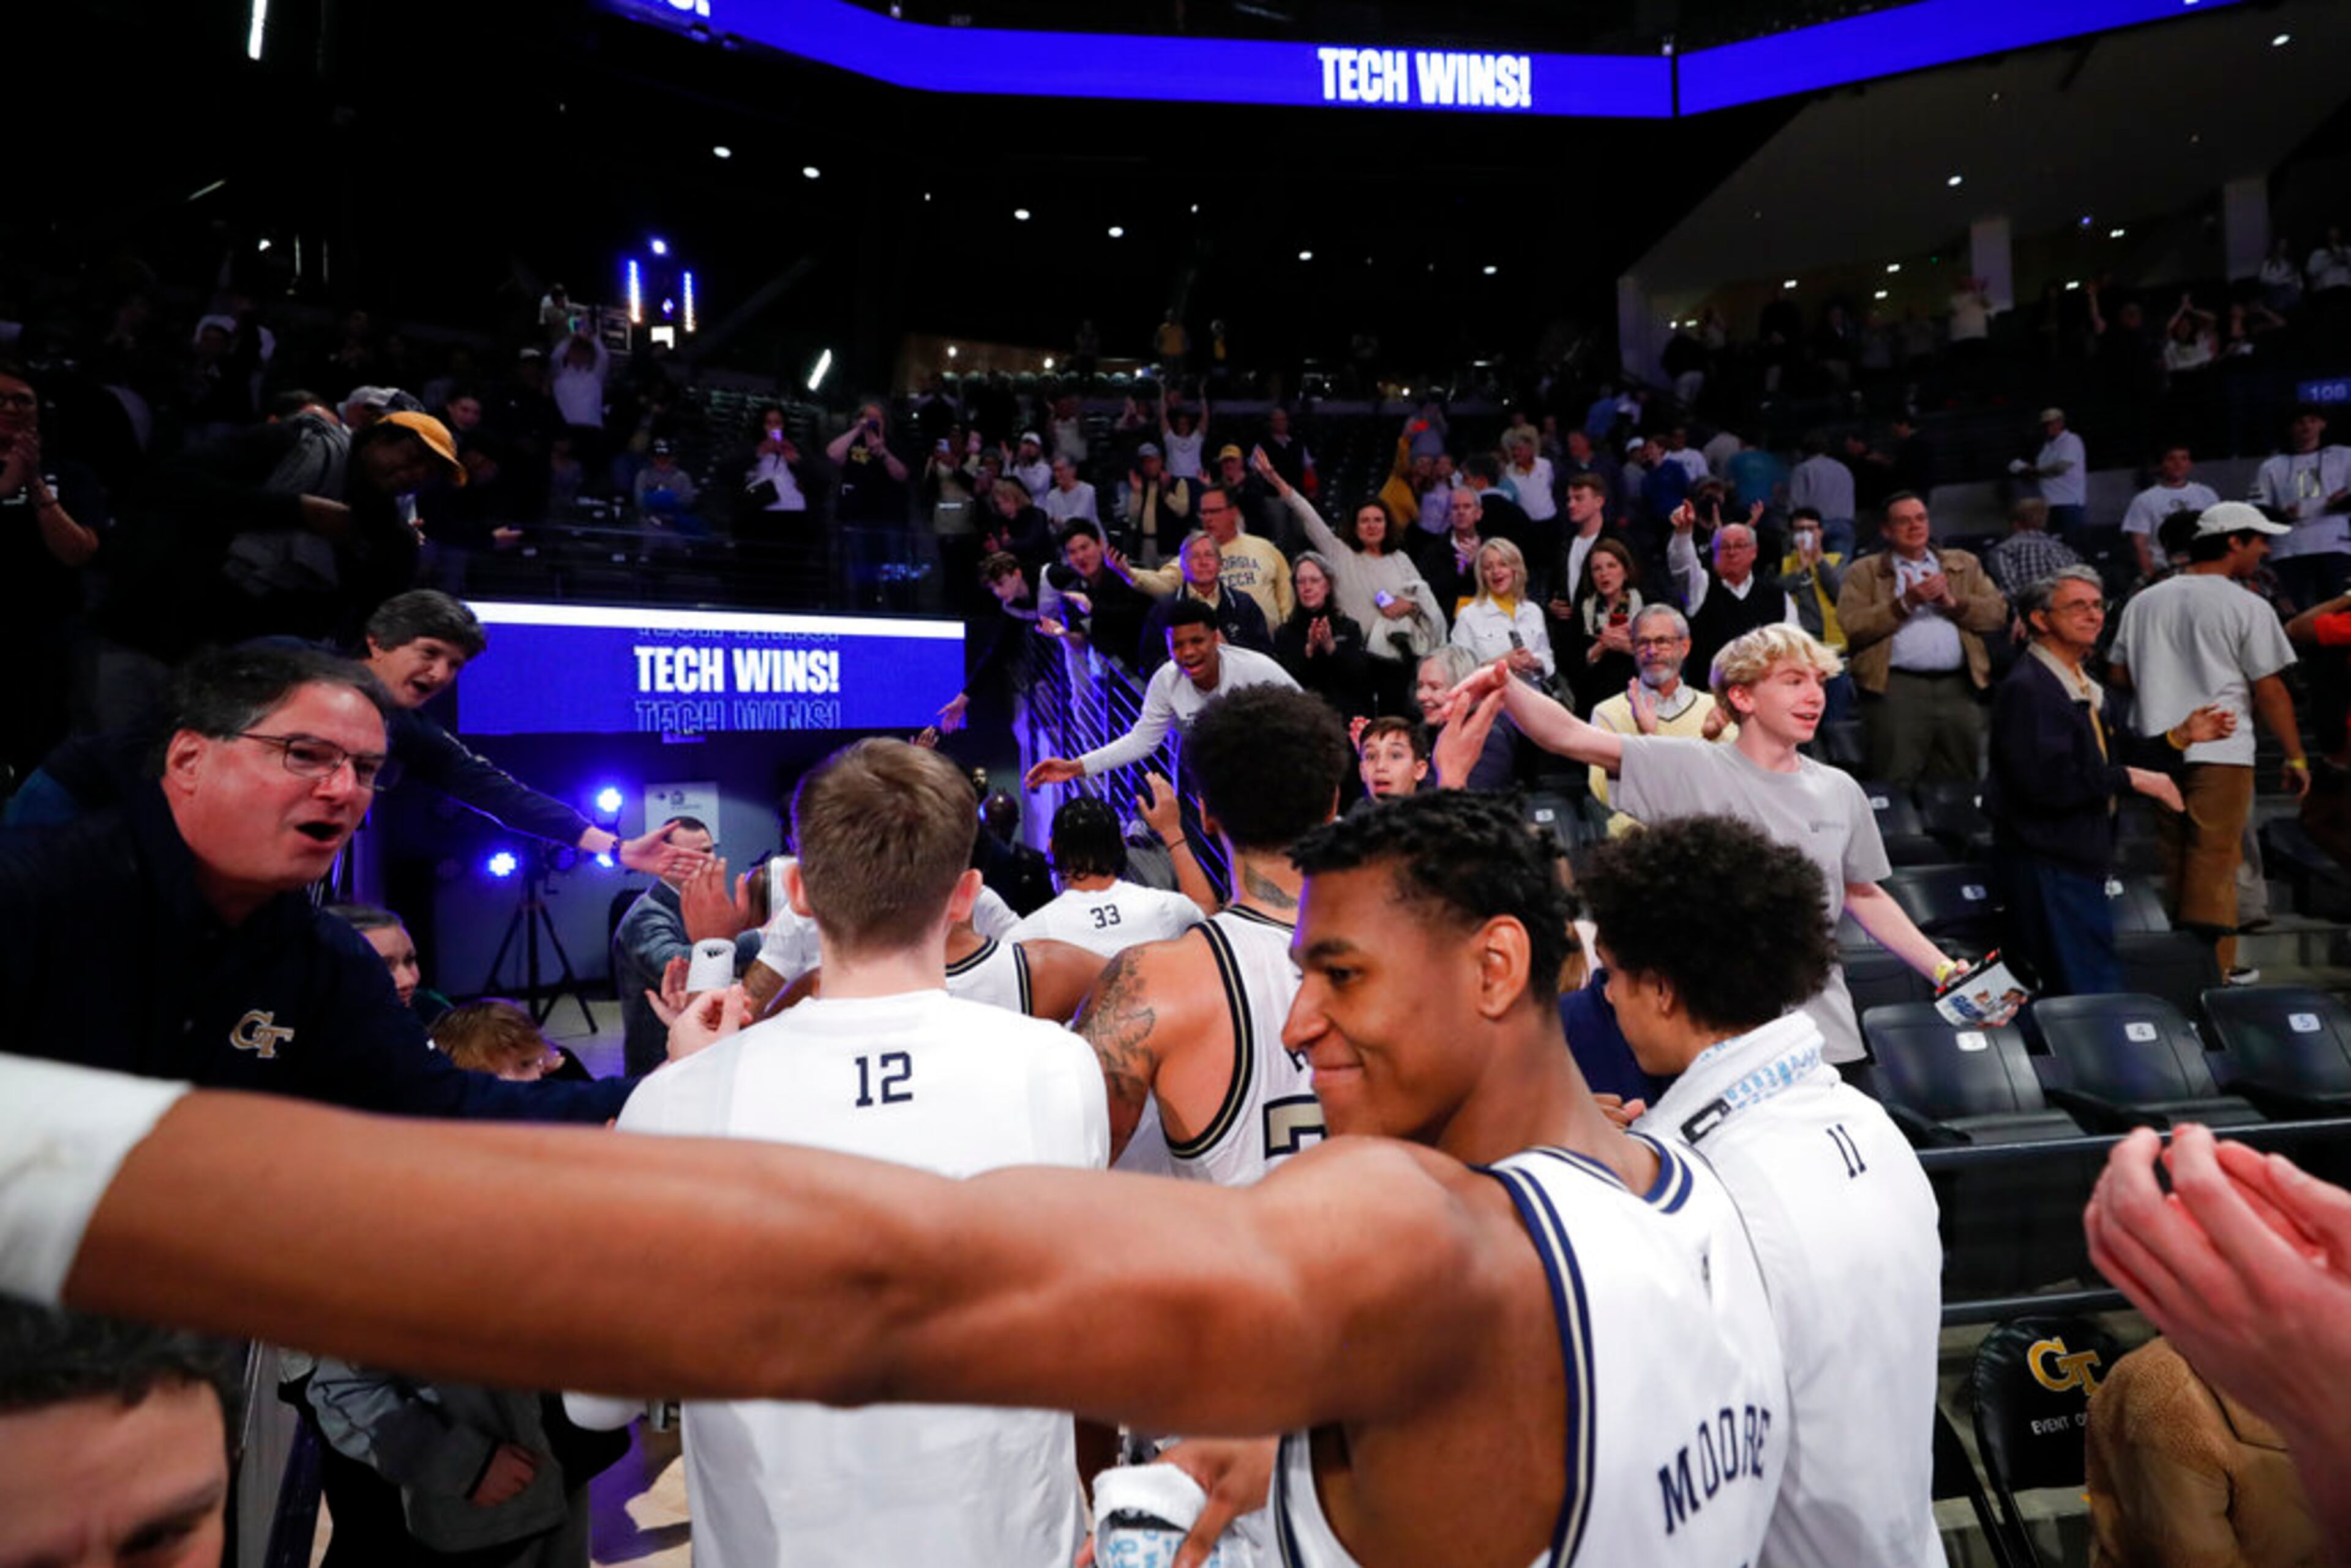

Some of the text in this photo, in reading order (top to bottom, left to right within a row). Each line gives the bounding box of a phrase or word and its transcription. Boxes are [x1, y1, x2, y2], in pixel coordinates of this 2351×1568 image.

[1318, 47, 1532, 108] TECH WINS!
[1221, 555, 1261, 571] ORGIA
[634, 646, 839, 693] TECH WINS!
[1090, 903, 1121, 929] 33
[855, 1051, 913, 1107] 12
[1826, 1123, 1867, 1179] 11
[2030, 1415, 2070, 1436] EVENT
[1657, 1405, 1771, 1536] MOORE
